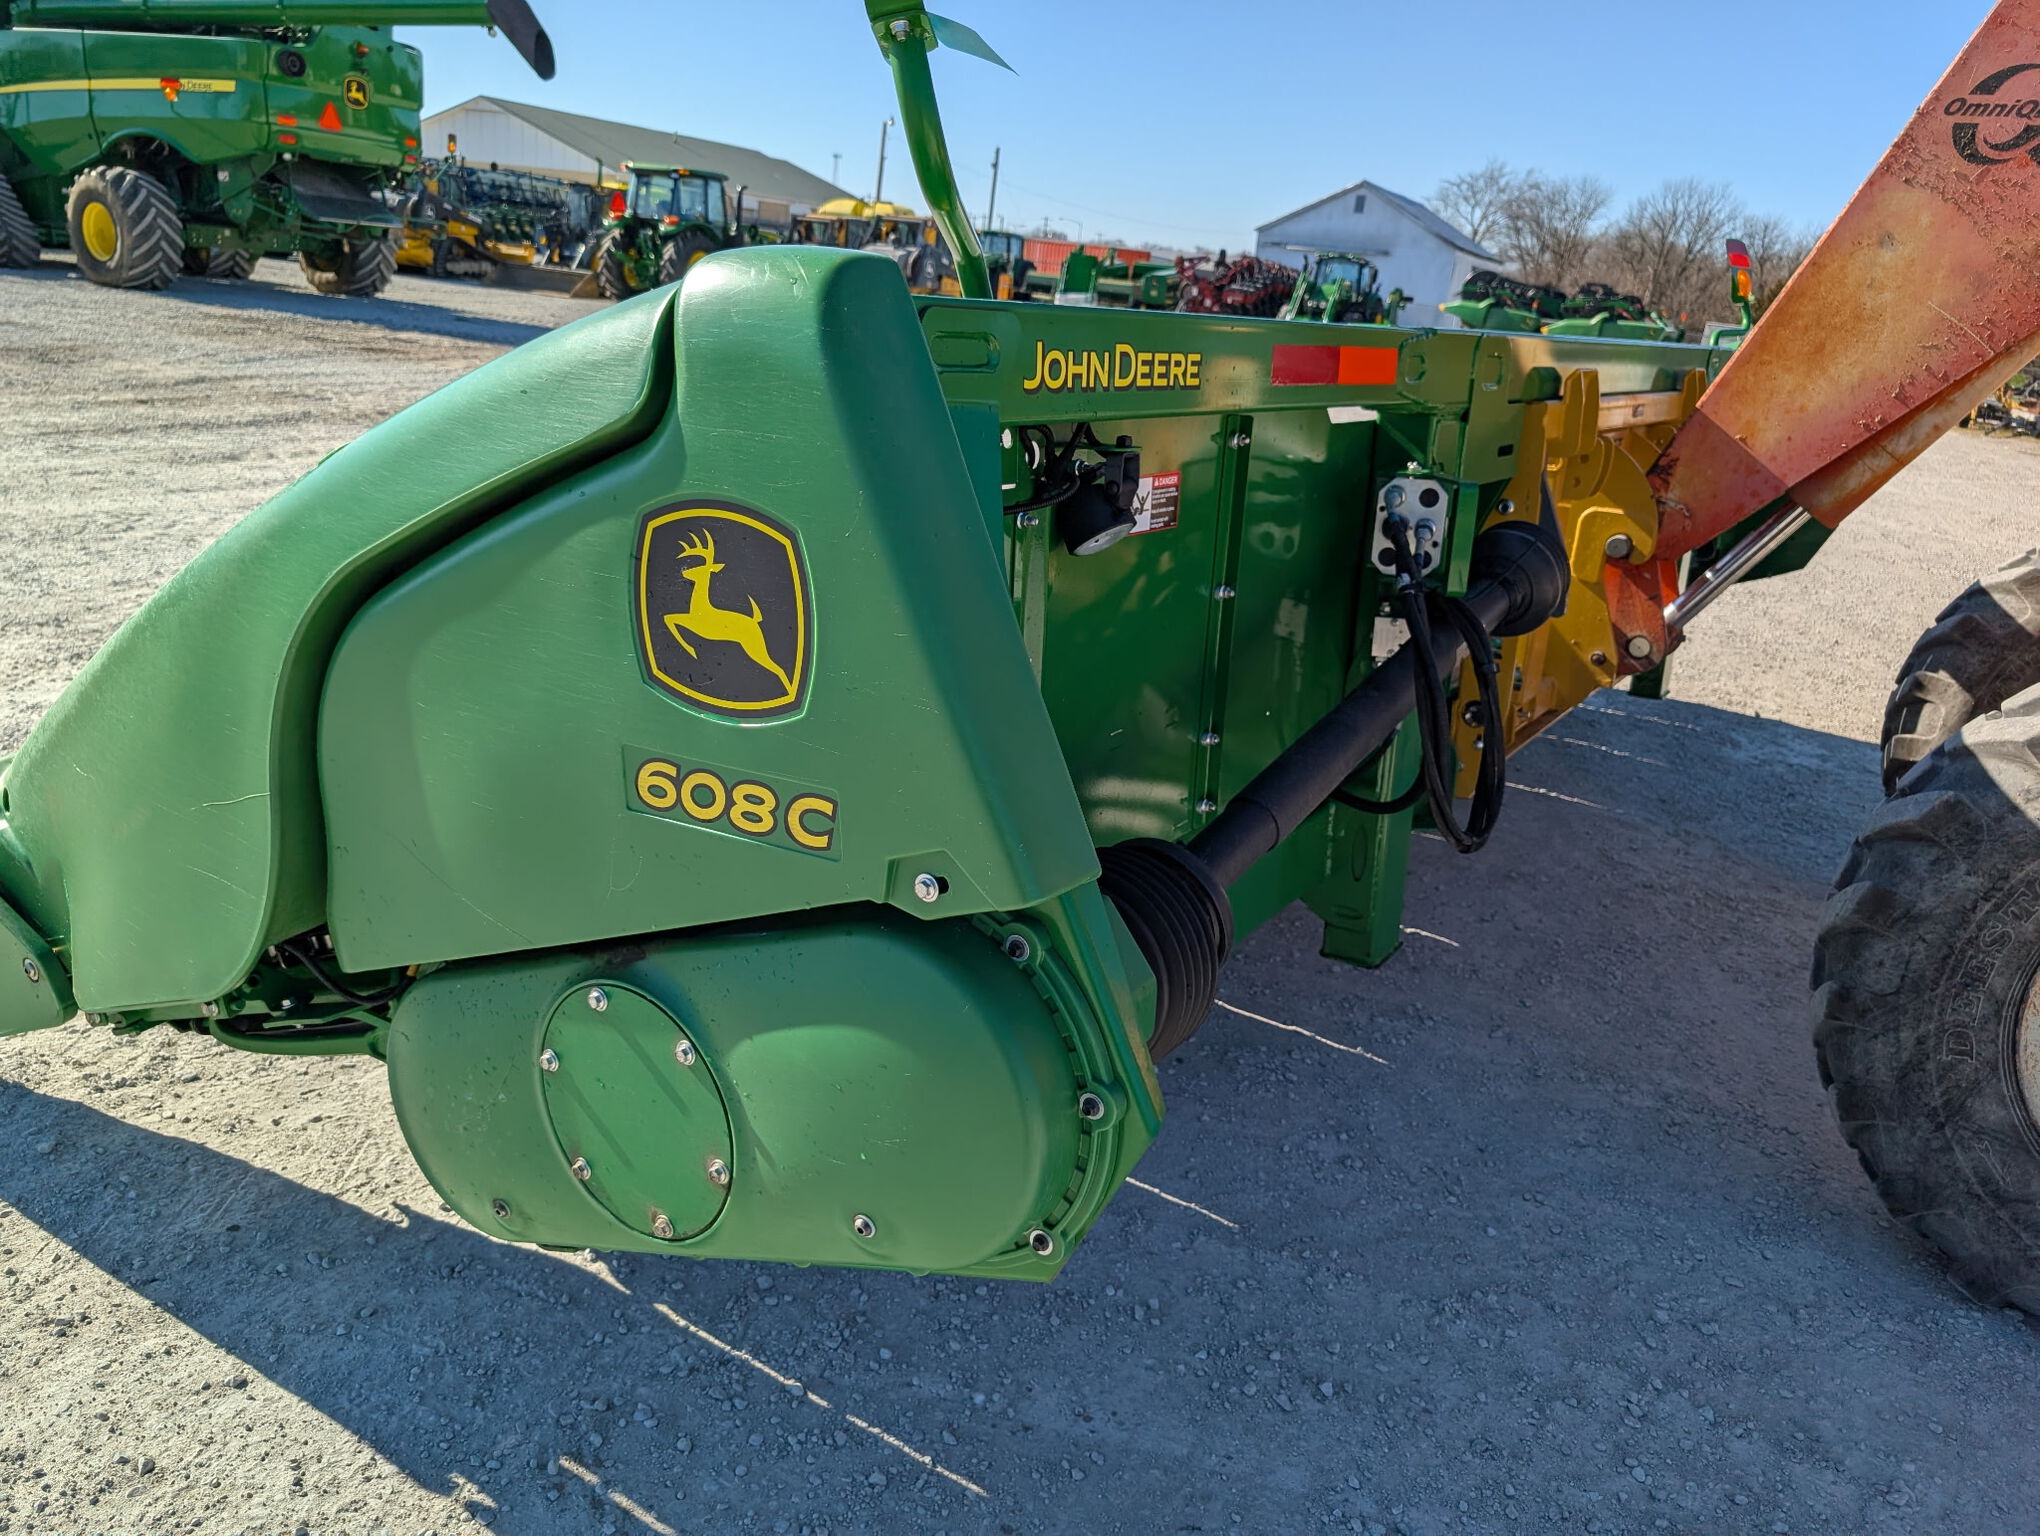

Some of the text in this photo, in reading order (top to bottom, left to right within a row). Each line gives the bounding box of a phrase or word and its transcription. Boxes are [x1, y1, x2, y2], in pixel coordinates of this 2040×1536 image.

[1023, 340, 1202, 394] JOHN DEERE
[1940, 876, 2040, 1063] DEEST
